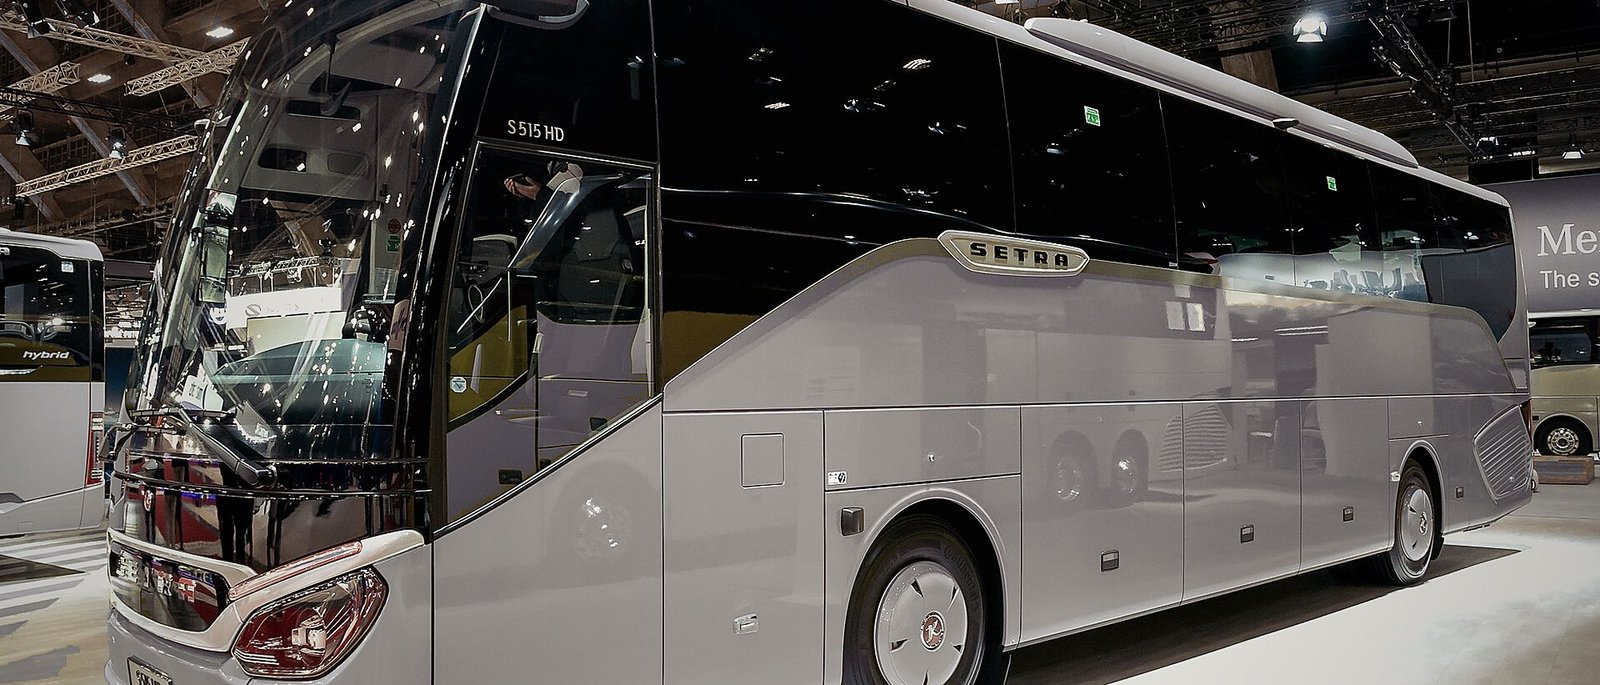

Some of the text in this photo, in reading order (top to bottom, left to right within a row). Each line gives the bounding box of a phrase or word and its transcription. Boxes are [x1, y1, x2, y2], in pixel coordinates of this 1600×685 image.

[507, 119, 565, 142] S 515 HD
[1537, 223, 1600, 257] Me
[969, 242, 1069, 267] SETRA
[1540, 270, 1580, 289] The
[23, 350, 69, 360] hybrid
